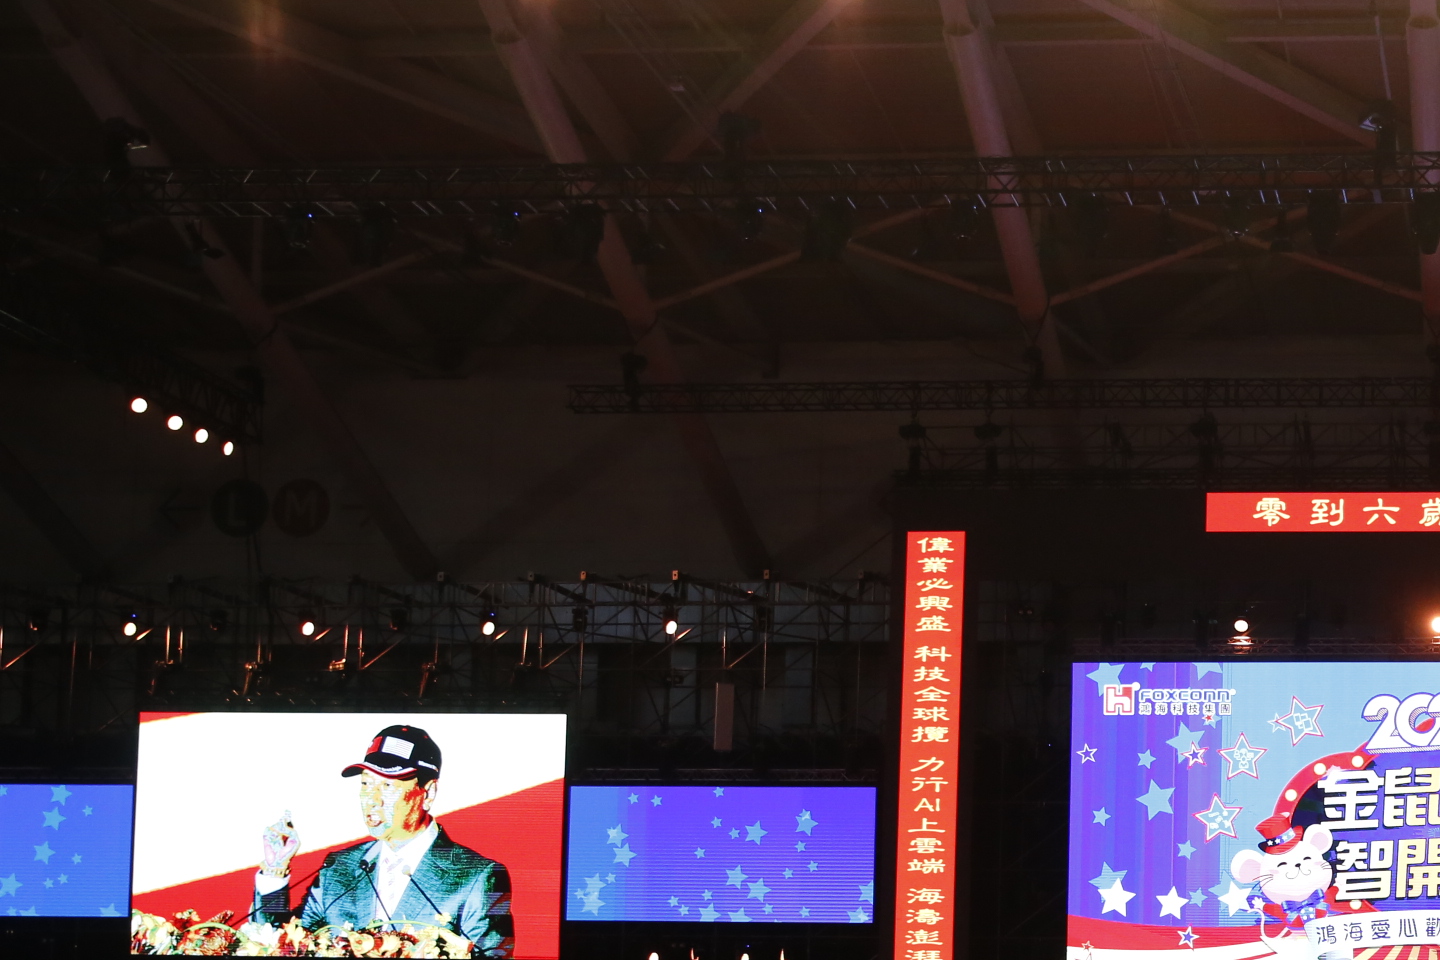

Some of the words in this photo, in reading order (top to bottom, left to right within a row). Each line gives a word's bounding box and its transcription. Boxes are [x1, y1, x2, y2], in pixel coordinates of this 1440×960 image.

[285, 489, 317, 527] M
[915, 536, 955, 632] 偉業必興盛
[911, 645, 952, 743] 科技全球攬
